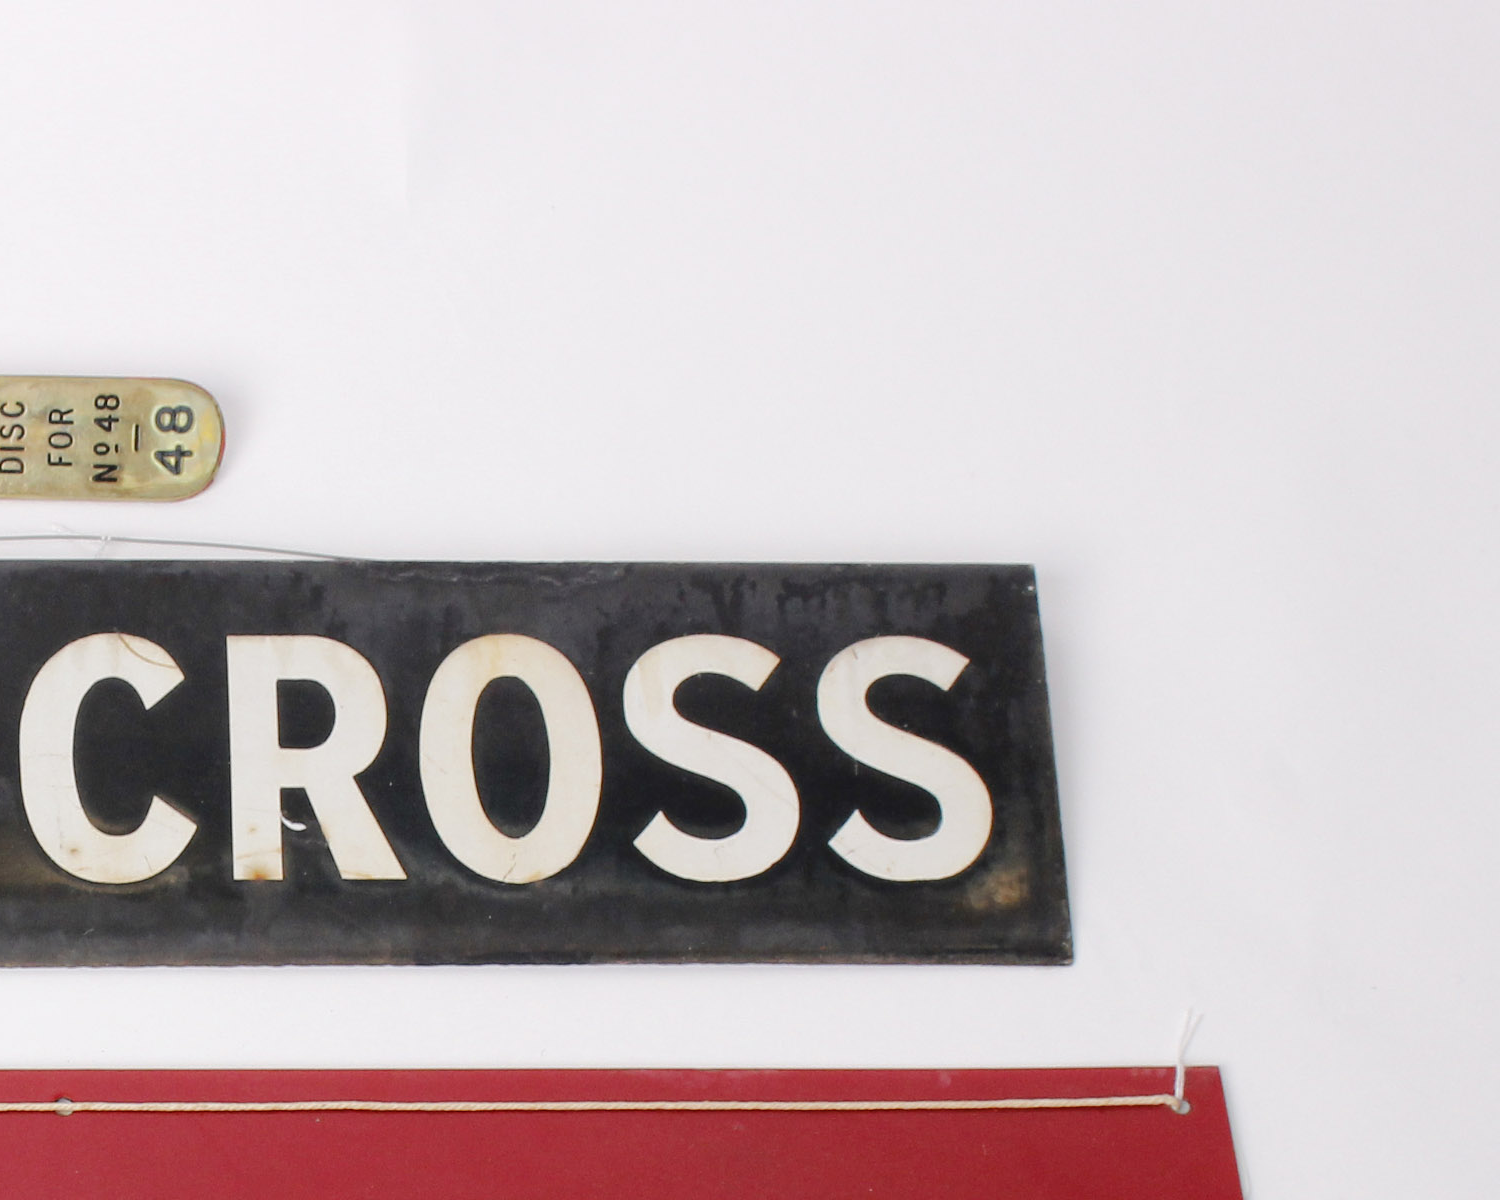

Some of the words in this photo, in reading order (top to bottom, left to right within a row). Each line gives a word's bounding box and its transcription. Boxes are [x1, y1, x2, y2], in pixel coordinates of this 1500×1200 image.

[47, 407, 75, 467] FOR
[155, 405, 194, 475] 48
[19, 632, 994, 885] CROSS
